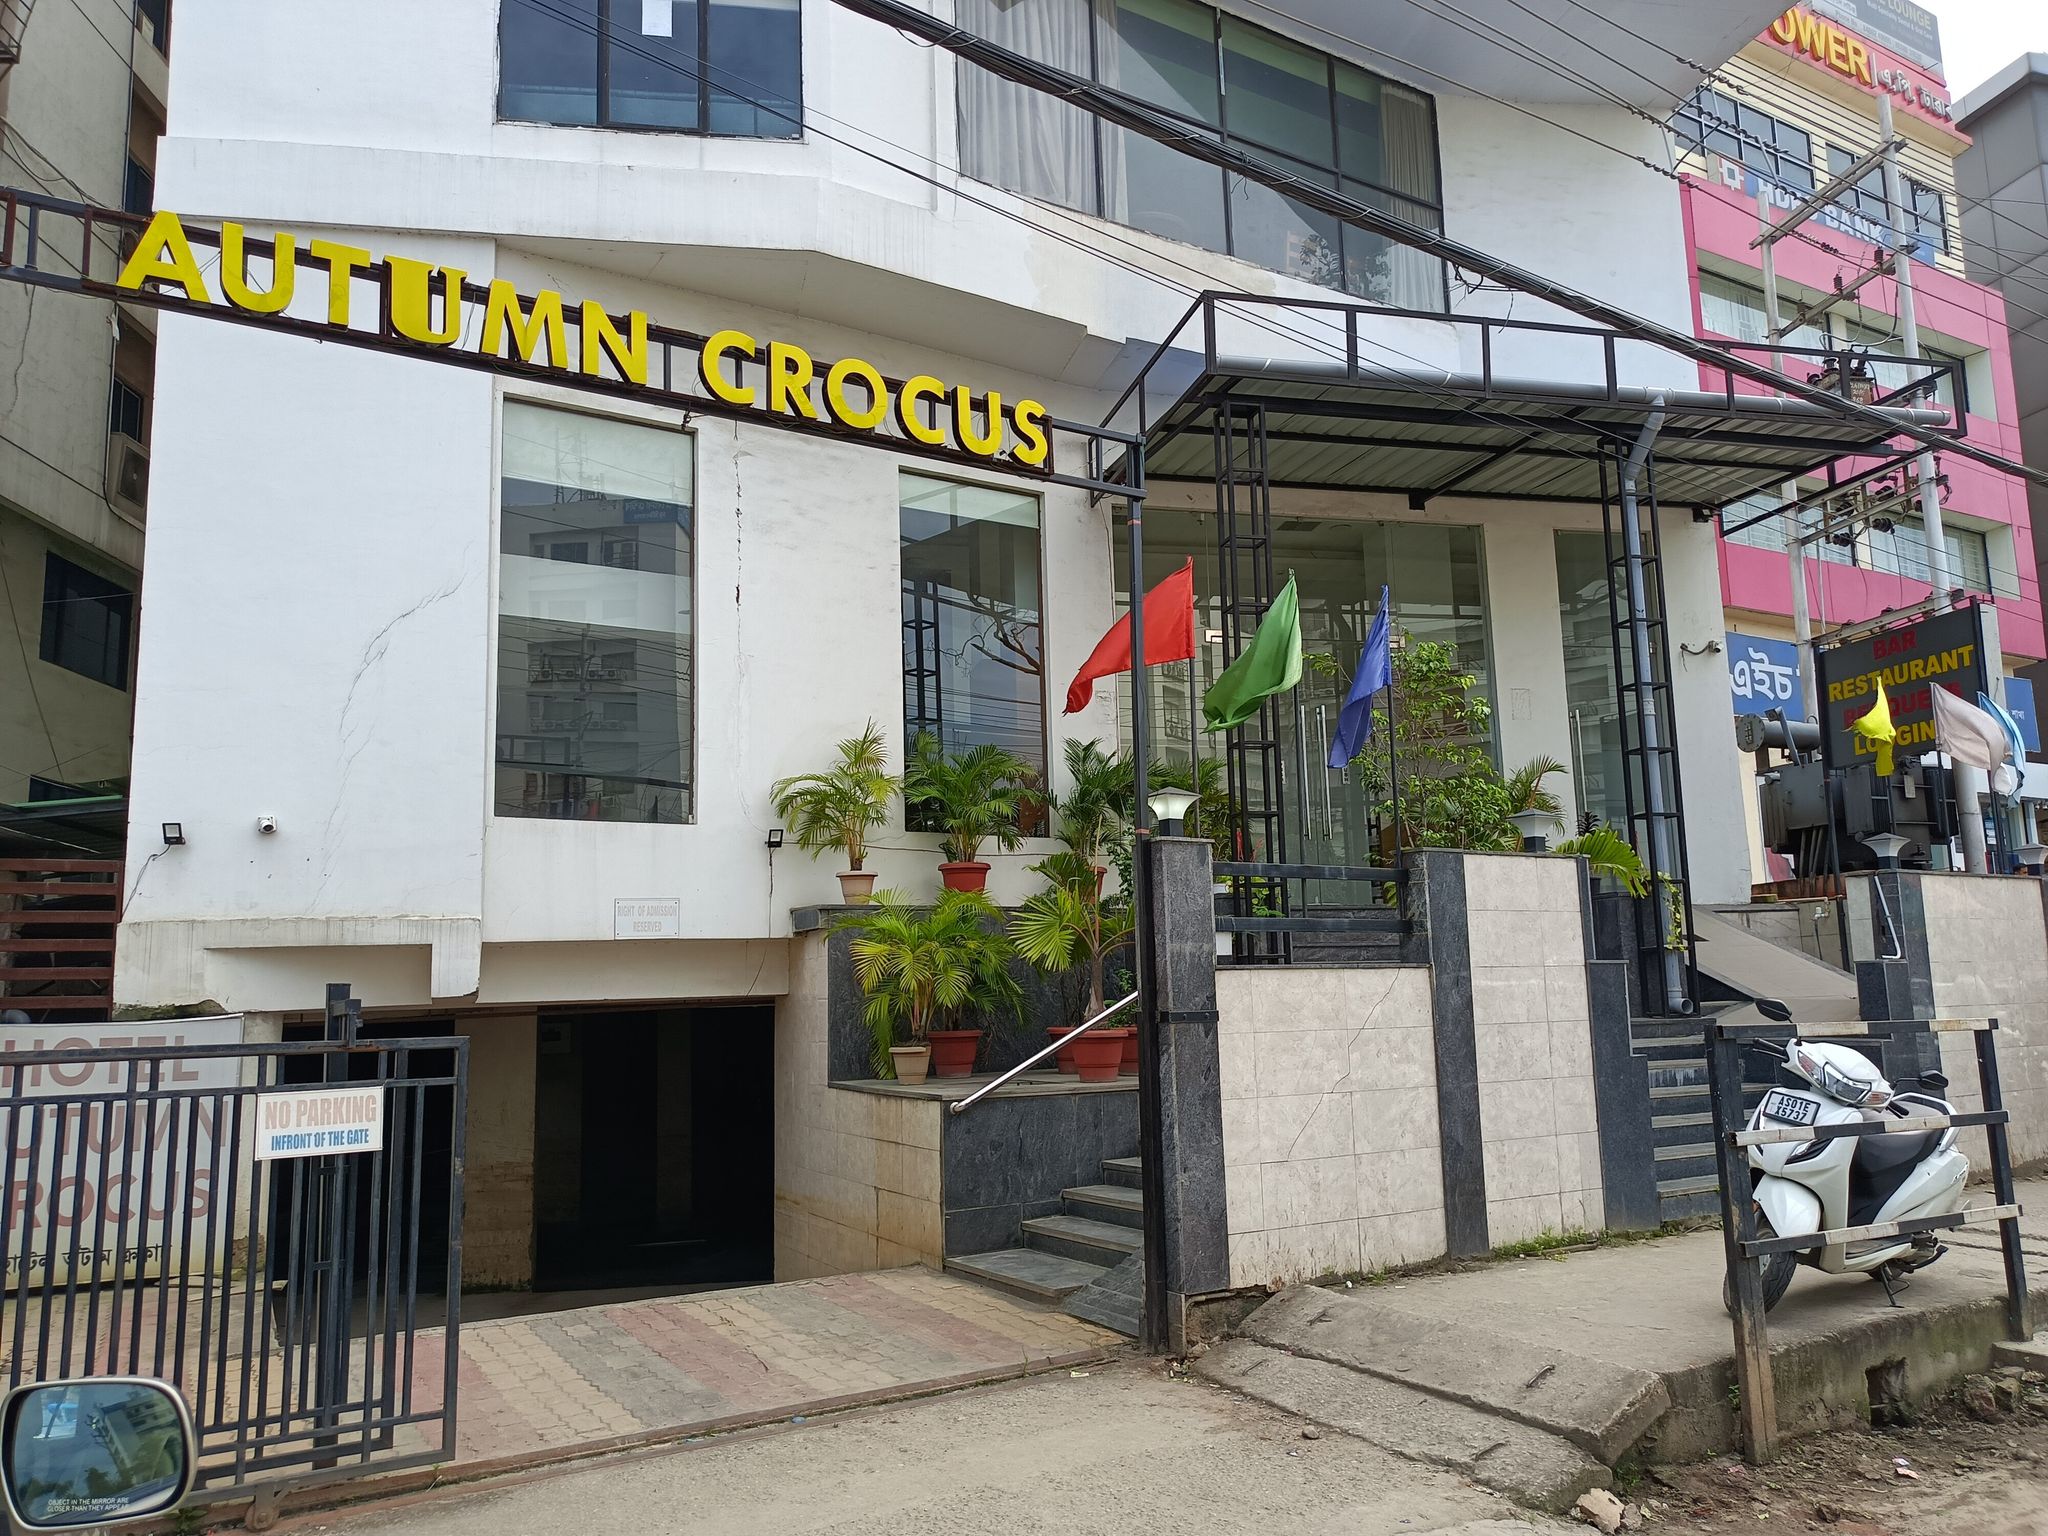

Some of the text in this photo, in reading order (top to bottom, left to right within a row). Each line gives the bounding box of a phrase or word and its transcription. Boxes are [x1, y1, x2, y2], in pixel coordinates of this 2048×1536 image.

[1758, 177, 1886, 247] HD BANK
[116, 210, 1049, 467] AUTUMN CROCUS
[1872, 630, 1918, 661] BAR
[1828, 645, 1975, 703] RESTAURANT
[1854, 720, 1936, 756] LOGIN
[633, 921, 662, 933] RESERVED
[638, 905, 646, 917] OF
[2, 1036, 199, 1088] HOTEL
[265, 1095, 377, 1130] NO PARKING
[1774, 1105, 1808, 1122] X5737
[1778, 1096, 1812, 1113] AS01E
[271, 1129, 370, 1151] INFRONT OF THE GATE
